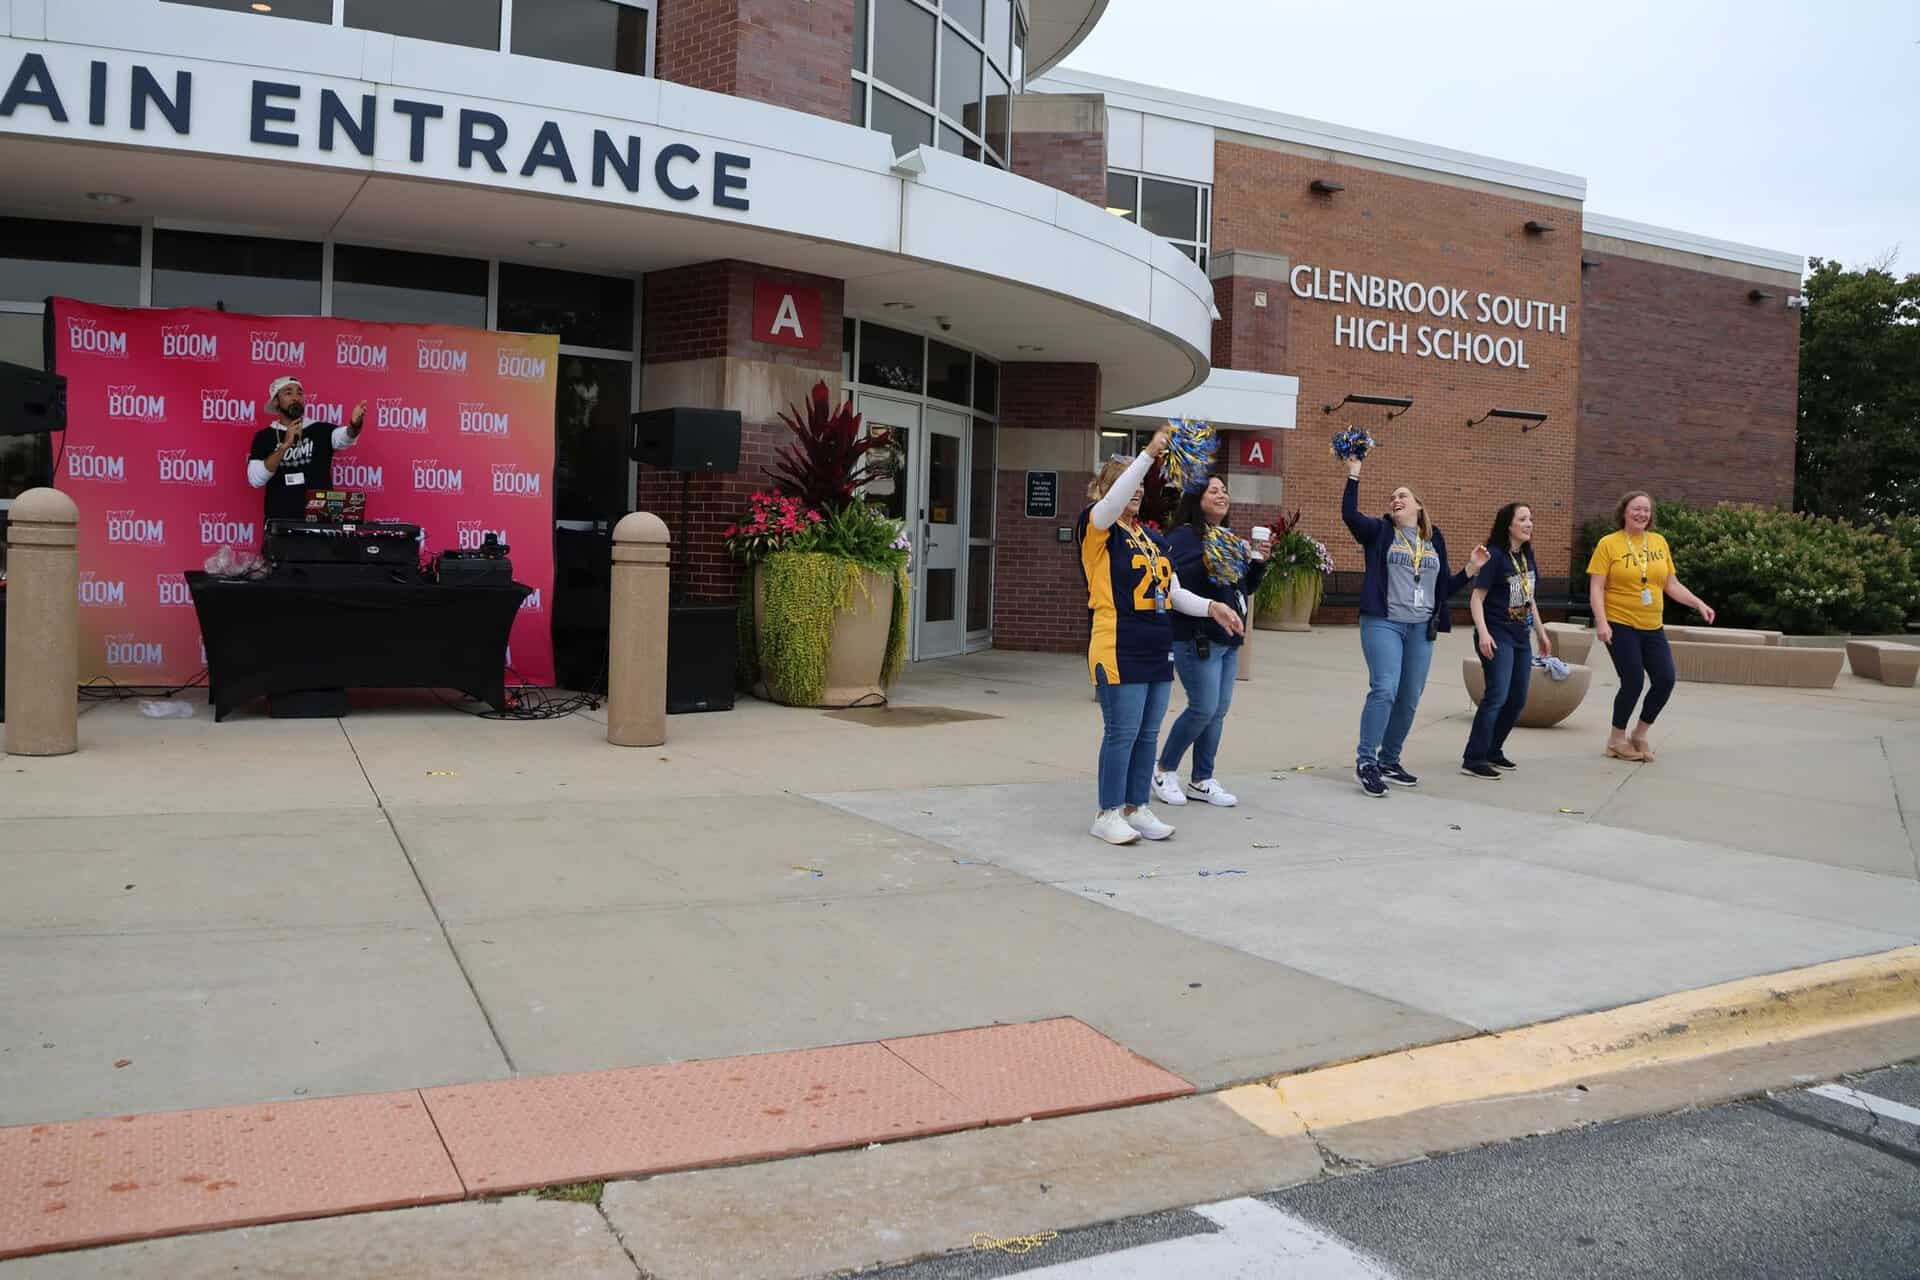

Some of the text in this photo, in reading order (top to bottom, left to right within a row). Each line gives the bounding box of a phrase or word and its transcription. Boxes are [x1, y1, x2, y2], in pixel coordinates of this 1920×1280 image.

[250, 80, 751, 211] ENTRANCE
[1290, 264, 1568, 334] GLENBROOK SOUTH
[770, 294, 804, 338] A
[70, 326, 126, 353] BOOM
[163, 334, 216, 357] BOOM
[1335, 315, 1530, 369] HIGH SCHOOL
[252, 341, 304, 363] BOOM
[337, 343, 387, 367] BOOM
[418, 349, 467, 371] BOOM
[498, 356, 545, 377] BOOM
[109, 395, 164, 418] BOOM
[202, 399, 255, 421] BOOM
[304, 403, 343, 425] OOM
[377, 407, 427, 428] BOOM
[460, 412, 507, 433] BOOM
[1249, 442, 1264, 463] A
[68, 454, 124, 478] BOOM
[159, 458, 213, 481] BOOM
[332, 466, 383, 486] BOOM
[414, 468, 462, 490] BOOM
[493, 472, 540, 493] BOOM
[108, 519, 163, 541] BOOM
[201, 522, 254, 544] BOOM
[107, 643, 162, 664] BOOM
